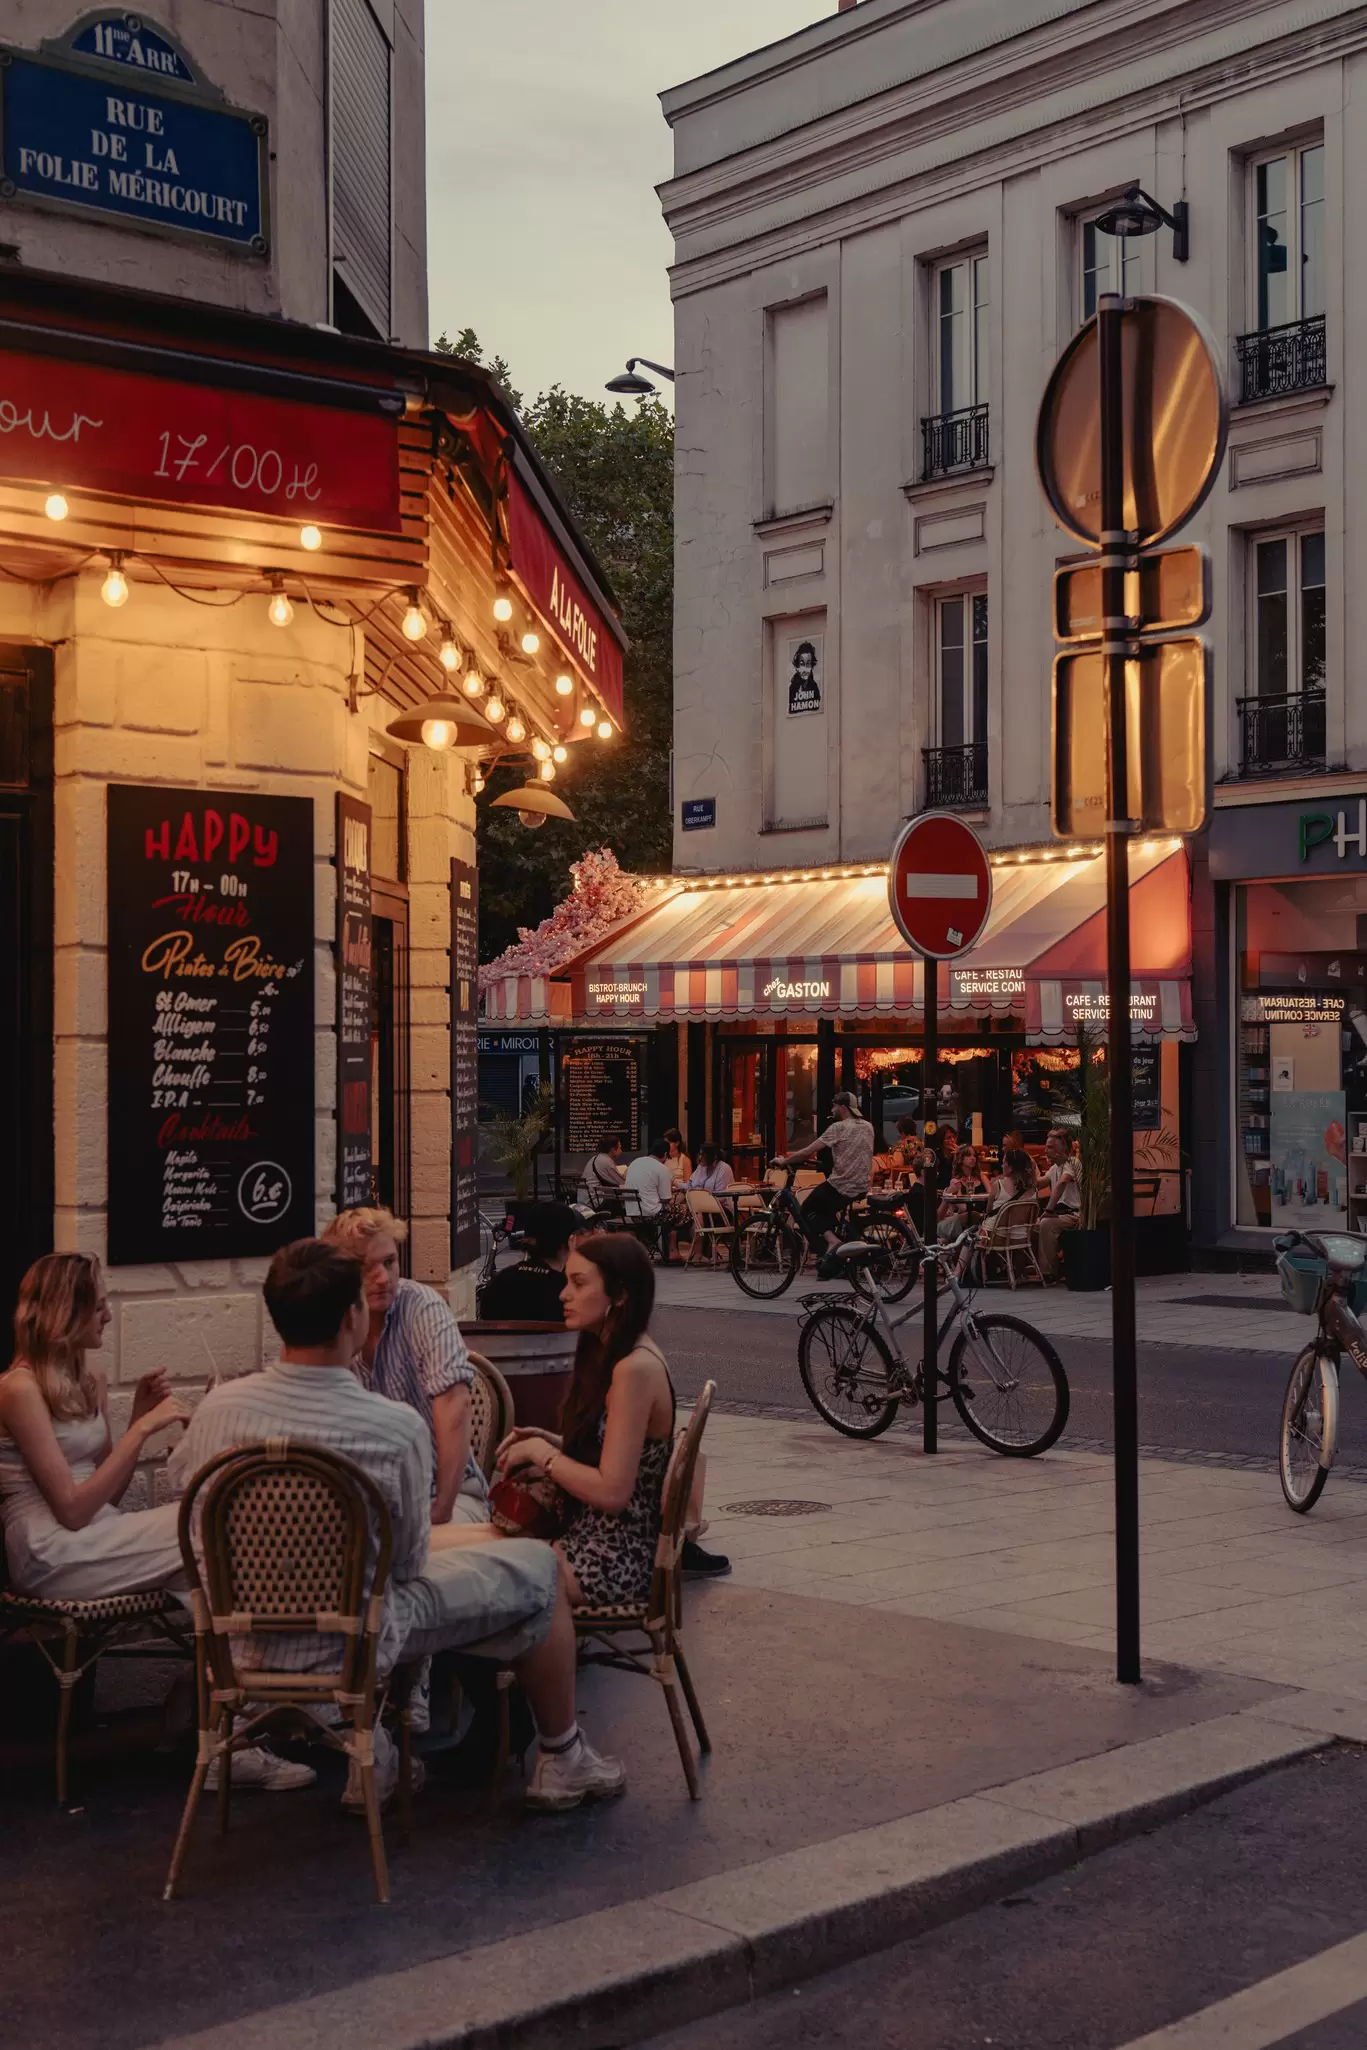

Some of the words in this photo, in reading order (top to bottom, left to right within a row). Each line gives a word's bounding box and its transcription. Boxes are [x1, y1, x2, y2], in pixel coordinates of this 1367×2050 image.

[106, 97, 164, 136] RUE
[91, 129, 127, 162] DE
[145, 142, 180, 176] LA
[18, 147, 99, 191] FOLIE
[108, 169, 248, 226] MÉRICOURT
[550, 565, 559, 618] A
[559, 583, 571, 638] LA
[572, 603, 597, 673] FOLIE
[790, 699, 819, 712] HAMON
[793, 689, 815, 701] JOHN
[693, 804, 704, 812] RUE
[145, 808, 278, 867] HAPPY
[152, 893, 251, 928] Hour
[142, 930, 215, 979] Pintes
[589, 983, 647, 993] BISTROT-BRUNCH
[596, 994, 618, 1003] HAPPY
[619, 993, 640, 1003] HOUR
[763, 977, 780, 996] chez
[777, 982, 830, 998] GASTON
[960, 982, 999, 993] SERVICE
[155, 991, 173, 1012] St
[173, 991, 218, 1013] Omer
[1066, 995, 1091, 1006] CAFE
[1072, 1008, 1111, 1020] SERVICE
[153, 1039, 216, 1062] Blanche
[574, 1045, 604, 1056] HAPPY
[606, 1045, 632, 1056] HOUR
[1142, 1057, 1154, 1066] jour
[152, 1063, 211, 1089] Chouffe
